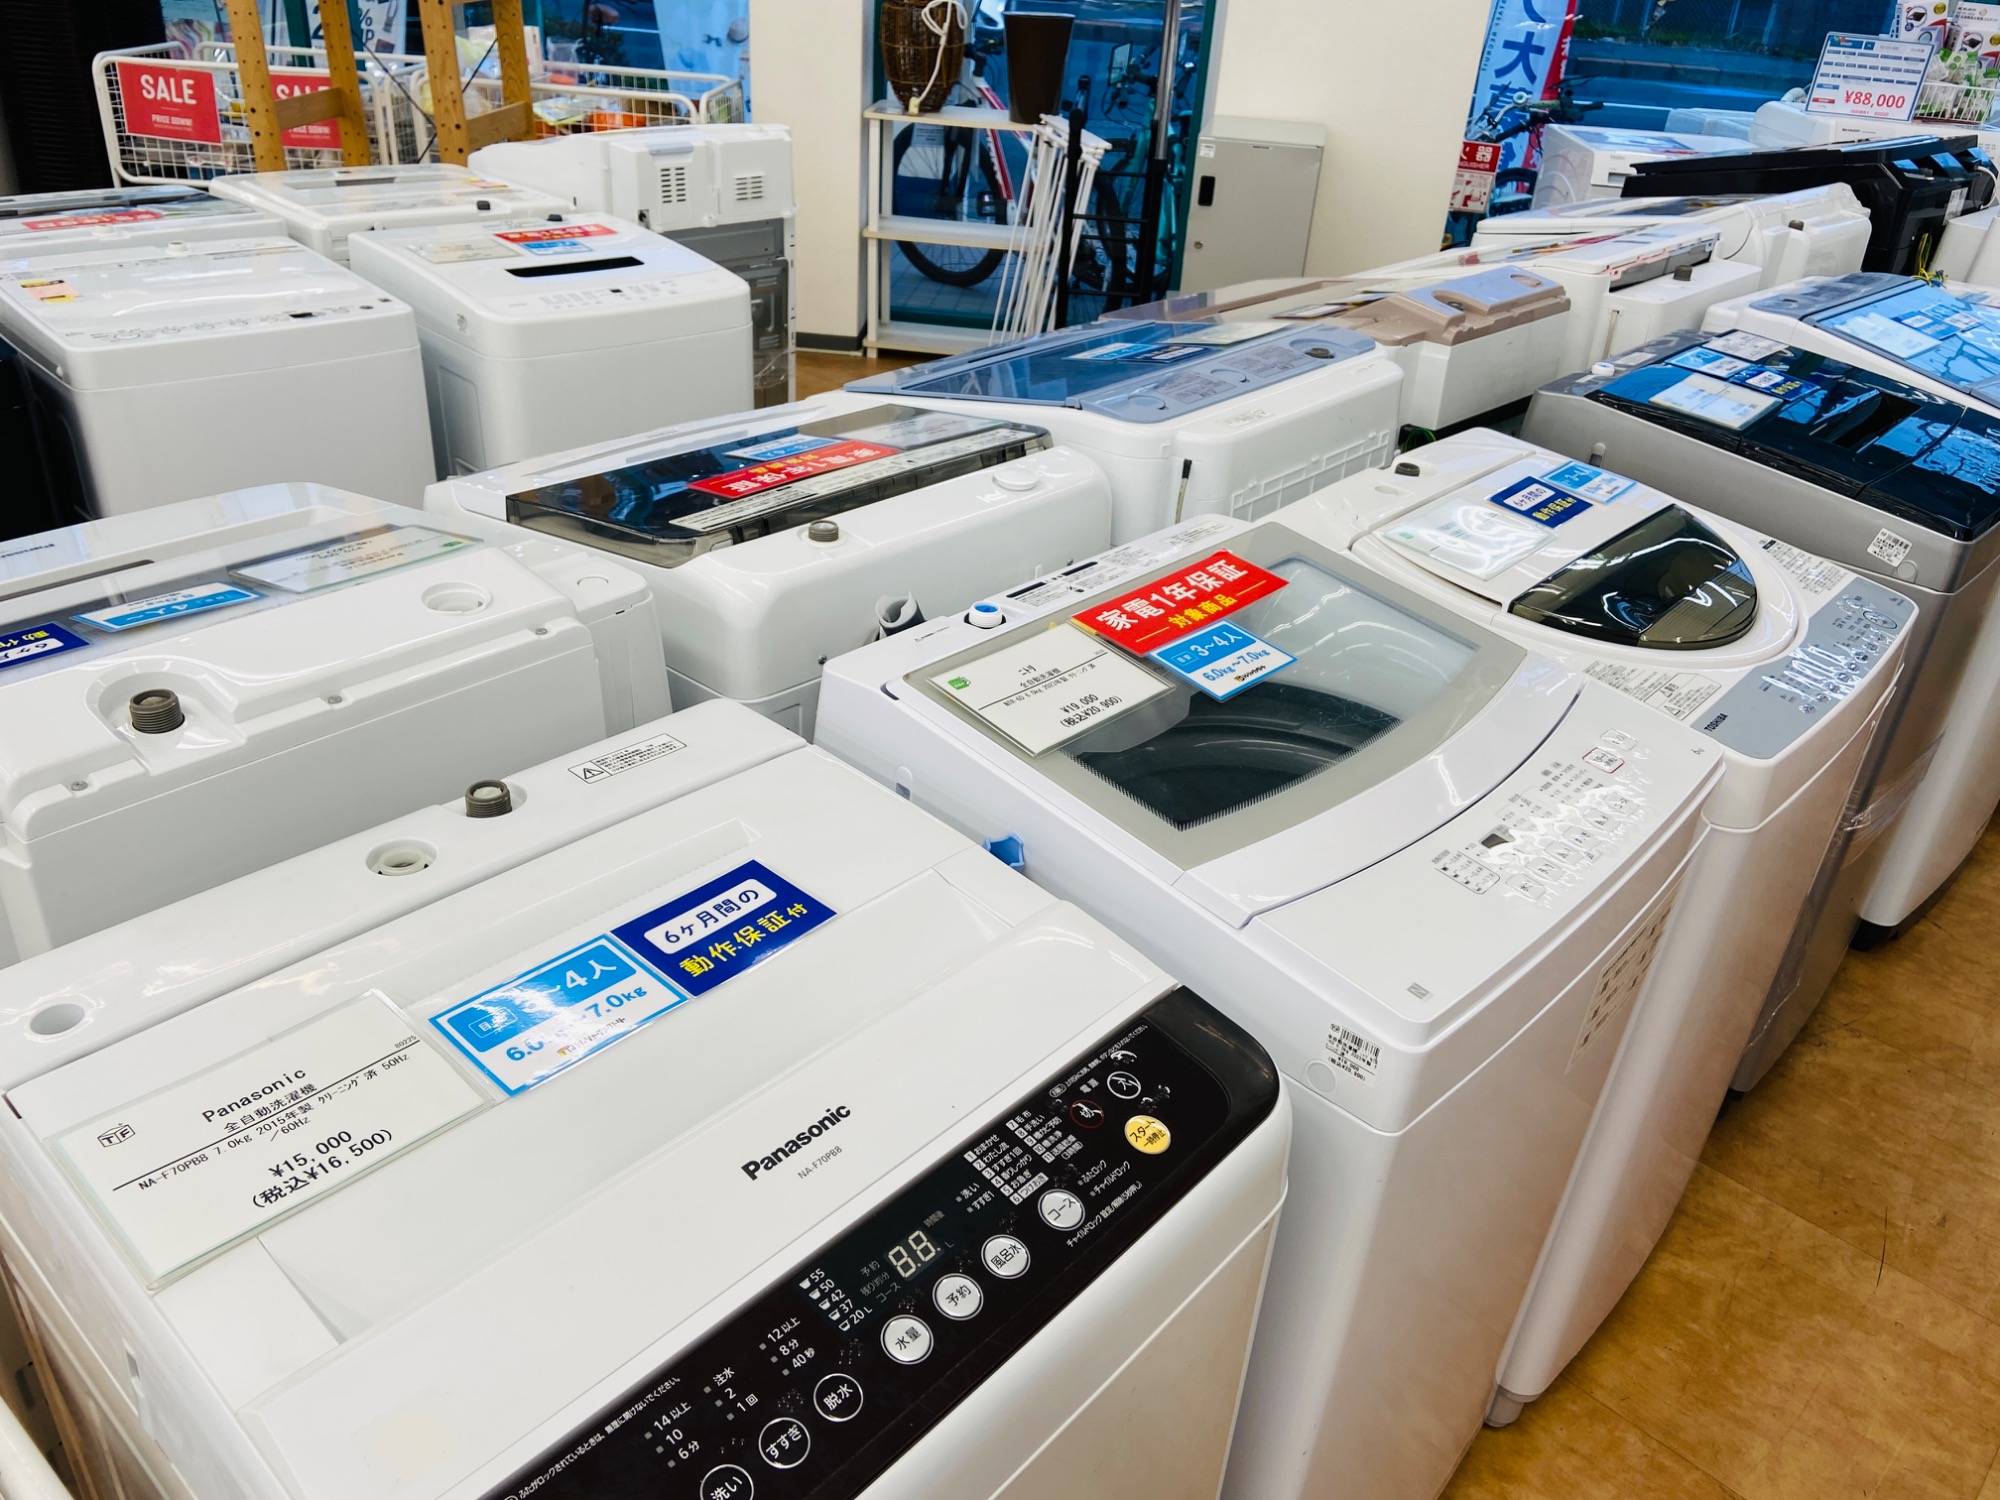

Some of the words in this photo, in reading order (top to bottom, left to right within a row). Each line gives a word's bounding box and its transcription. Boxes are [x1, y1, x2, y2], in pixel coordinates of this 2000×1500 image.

[140, 74, 197, 105] SALE
[1844, 90, 1905, 108] ¥88,000
[722, 448, 881, 492] 家電1年保証
[1097, 560, 1248, 632] 家電1年保証
[1168, 593, 1238, 629] 対象商品
[1020, 667, 1061, 688] 全自動洗濯機
[1060, 693, 1099, 714] ¥19,000
[1060, 694, 1123, 729] (税込¥20,900)
[1704, 713, 1728, 732] TOSHIBA
[679, 902, 809, 978] 動作保証付
[394, 1035, 417, 1050] 80225
[201, 1068, 307, 1123] Panasonic
[223, 1083, 318, 1134] 全自動洗濯機
[138, 1154, 209, 1191] NA-F70PB8
[213, 1133, 253, 1158] 7.0kg
[257, 1103, 315, 1136] 2015年製
[364, 1068, 378, 1081] 済
[382, 1053, 410, 1071] 50Hz
[1023, 1115, 1046, 1131] 手洗い
[1128, 1120, 1156, 1143] スタート
[268, 1130, 353, 1178] ¥15,000
[741, 1105, 851, 1181] Panasonic
[972, 1134, 1000, 1154] おまかせ
[980, 1142, 1010, 1162] わたし流
[251, 1128, 393, 1209] (税込¥16,500)
[797, 1145, 843, 1180] NA-F70PB8
[990, 1146, 1024, 1170] すすぎ1回
[1008, 1169, 1033, 1188] お急ぎ
[1081, 1159, 1107, 1183] ふたロック
[1094, 1161, 1131, 1194] チャイルドロック
[960, 1182, 980, 1200] 洗い
[1018, 1175, 1047, 1196] つけおき
[972, 1191, 995, 1210] すすぎ1
[1047, 1197, 1076, 1221] コース
[1066, 1216, 1103, 1247] チャイルドロック
[990, 1242, 1022, 1270] 風呂水
[810, 1268, 825, 1284] 55
[859, 1260, 881, 1277] 予約
[819, 1278, 836, 1294] 50
[830, 1289, 846, 1304] 42
[875, 1282, 901, 1304] コース
[945, 1284, 972, 1307] 予約
[839, 1298, 854, 1314] 37
[767, 1316, 801, 1344] 12以上
[895, 1326, 922, 1351] 水量
[779, 1338, 800, 1356] 8分
[791, 1347, 816, 1369] 40秒
[712, 1366, 735, 1387] 注水
[724, 1388, 737, 1400] 2
[822, 1382, 854, 1411] 脱水
[653, 1401, 692, 1432] 14以上
[665, 1428, 684, 1446] 10
[765, 1424, 804, 1459] すすぎ
[678, 1439, 700, 1461] 6分
[710, 1476, 743, 1500] 洗い
